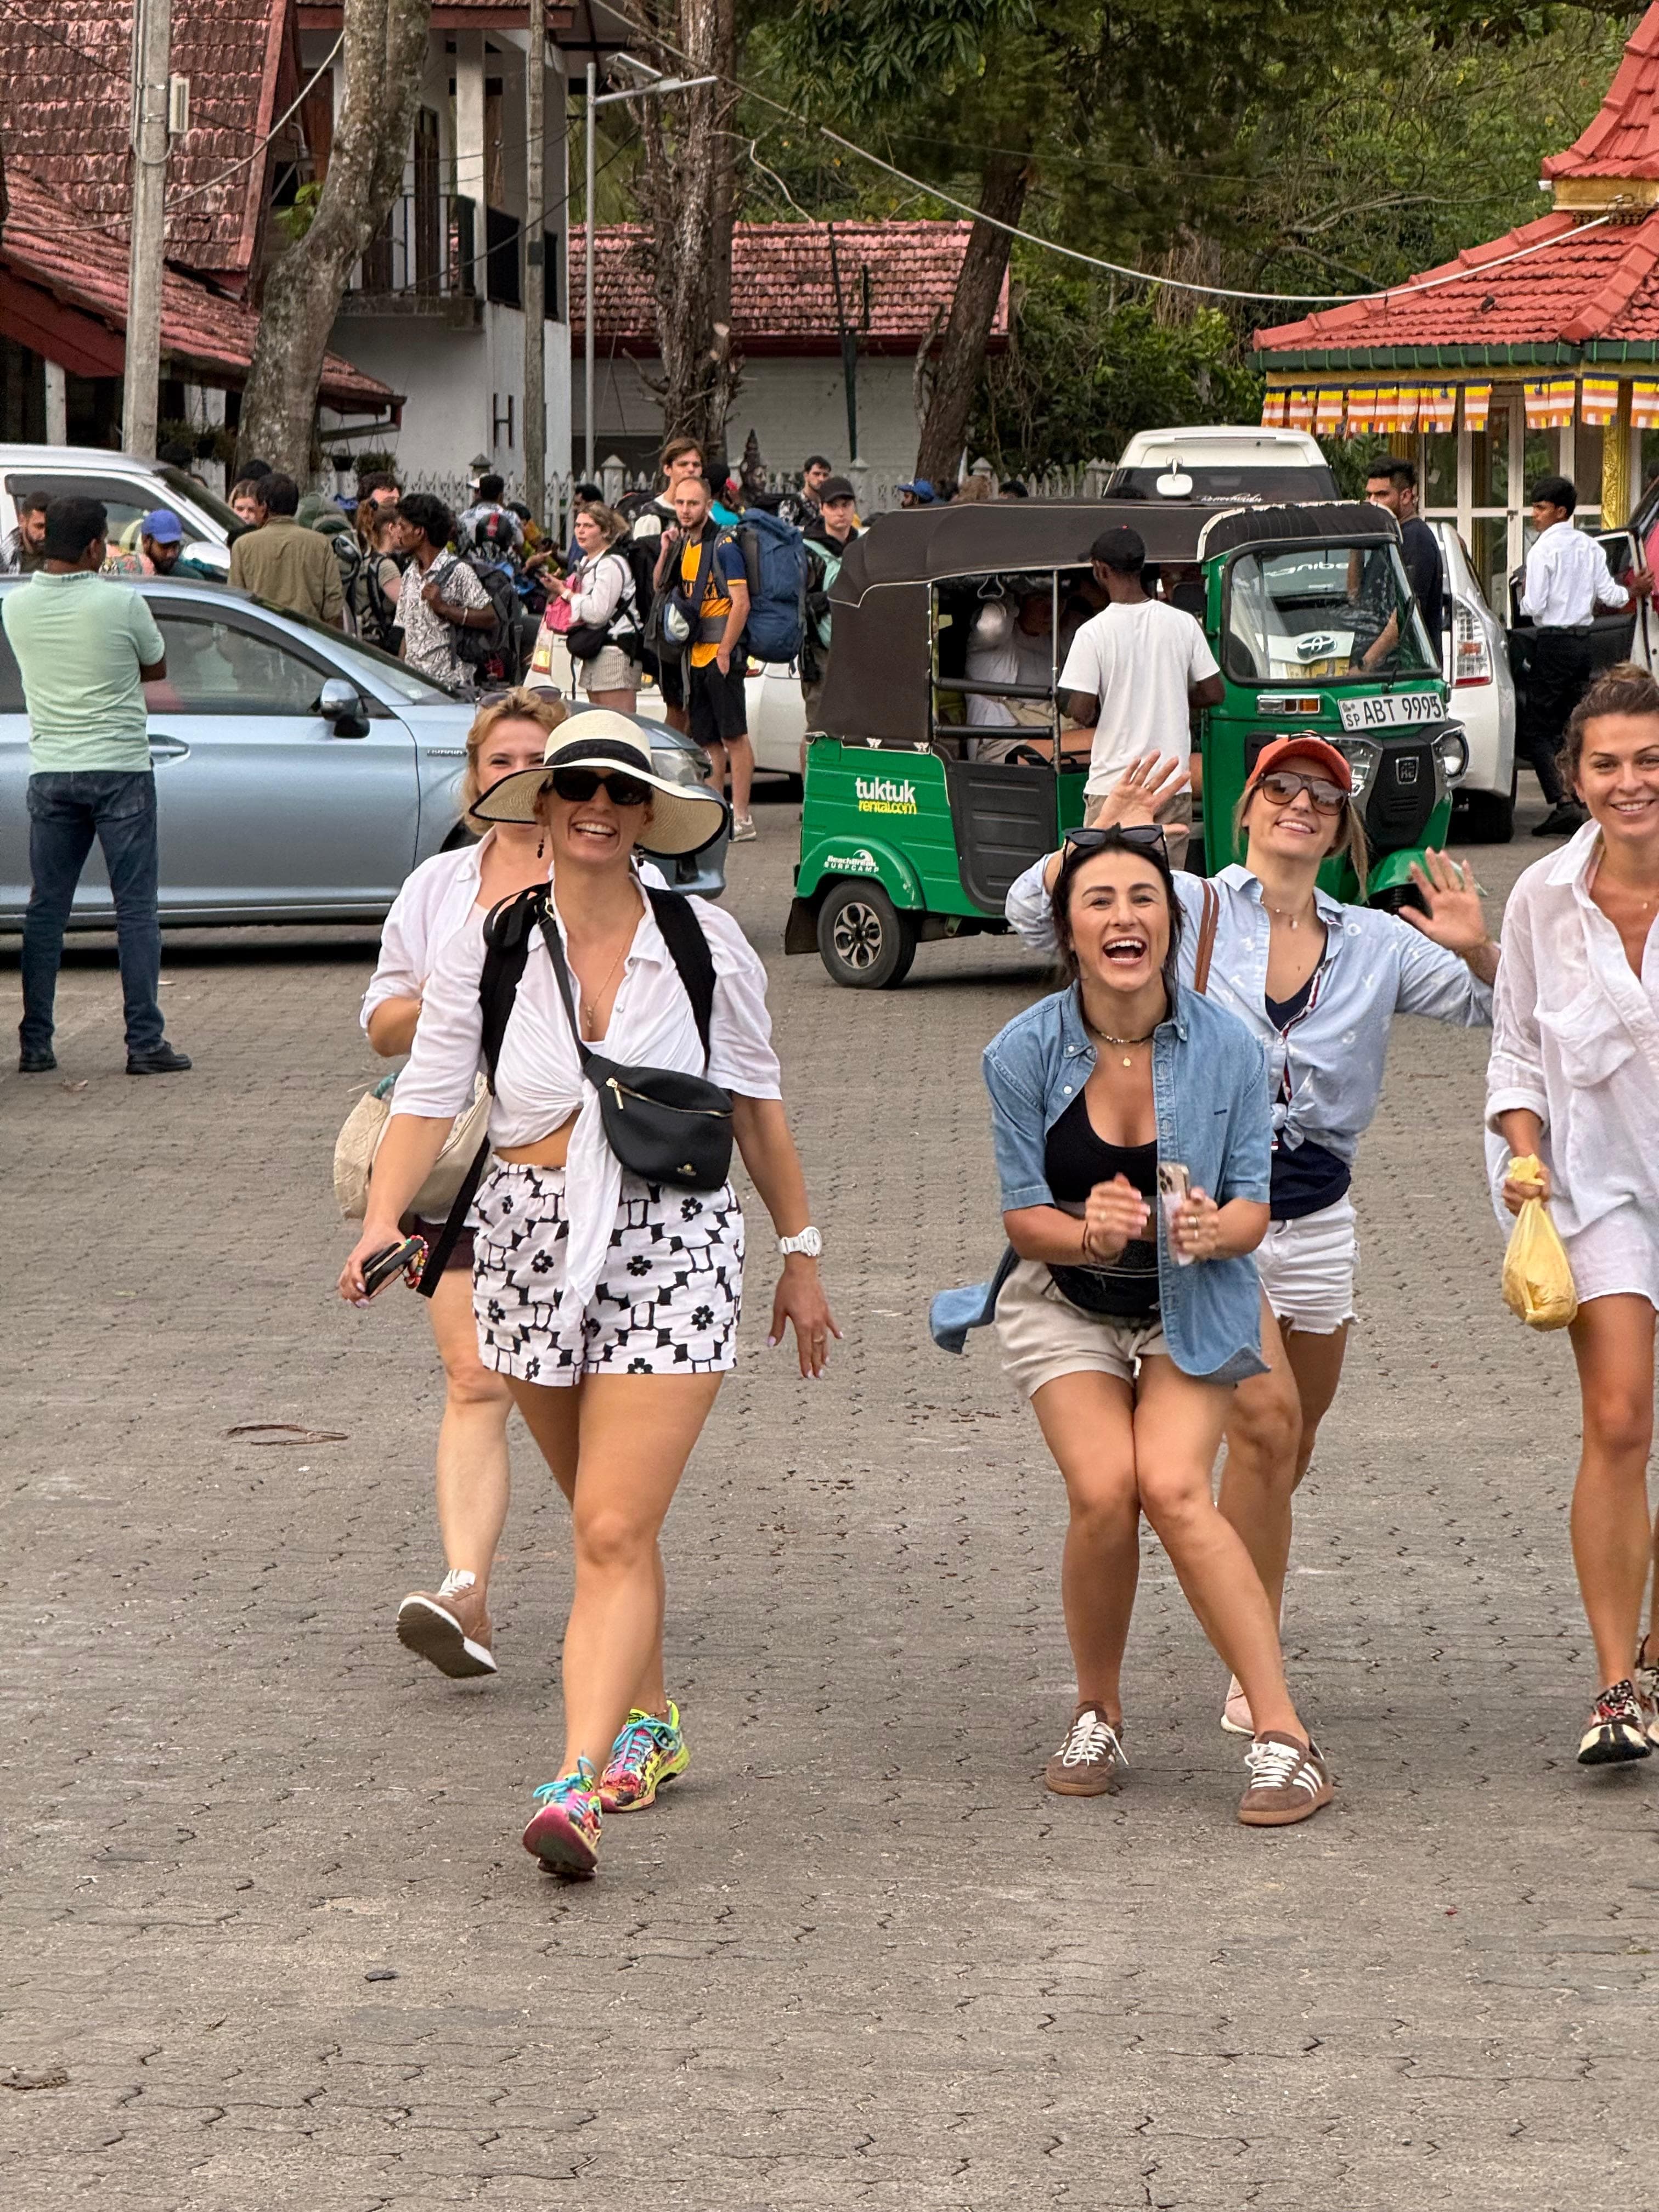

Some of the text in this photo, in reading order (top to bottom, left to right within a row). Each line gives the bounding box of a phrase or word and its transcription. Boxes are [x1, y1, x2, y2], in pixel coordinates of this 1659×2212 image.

[1346, 695, 1442, 727] SP ABT 9995
[855, 776, 916, 804] tuktuk
[858, 800, 917, 815] rental.com
